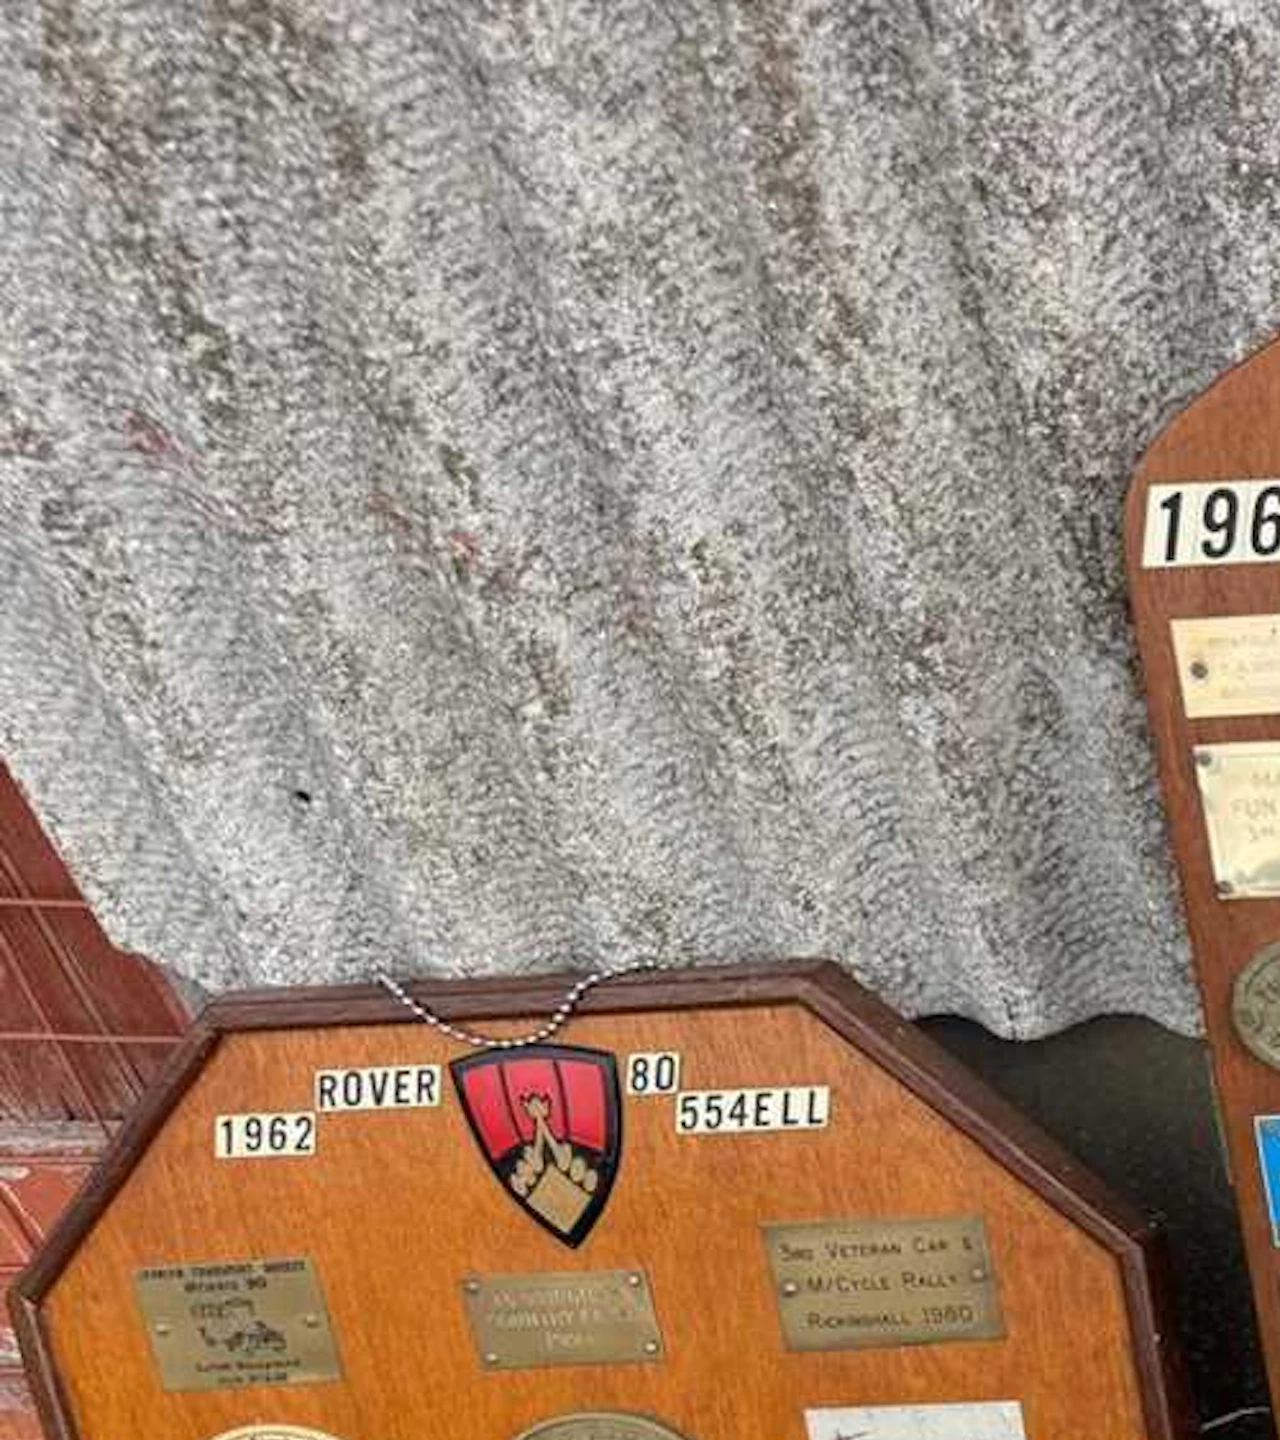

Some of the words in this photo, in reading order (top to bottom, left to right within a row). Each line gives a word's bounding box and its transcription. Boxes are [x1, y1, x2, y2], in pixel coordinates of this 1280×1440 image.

[319, 1070, 436, 1107] ROVER
[631, 1057, 675, 1091] 80
[680, 1091, 823, 1129] 554ELL
[221, 1117, 313, 1154] 1962
